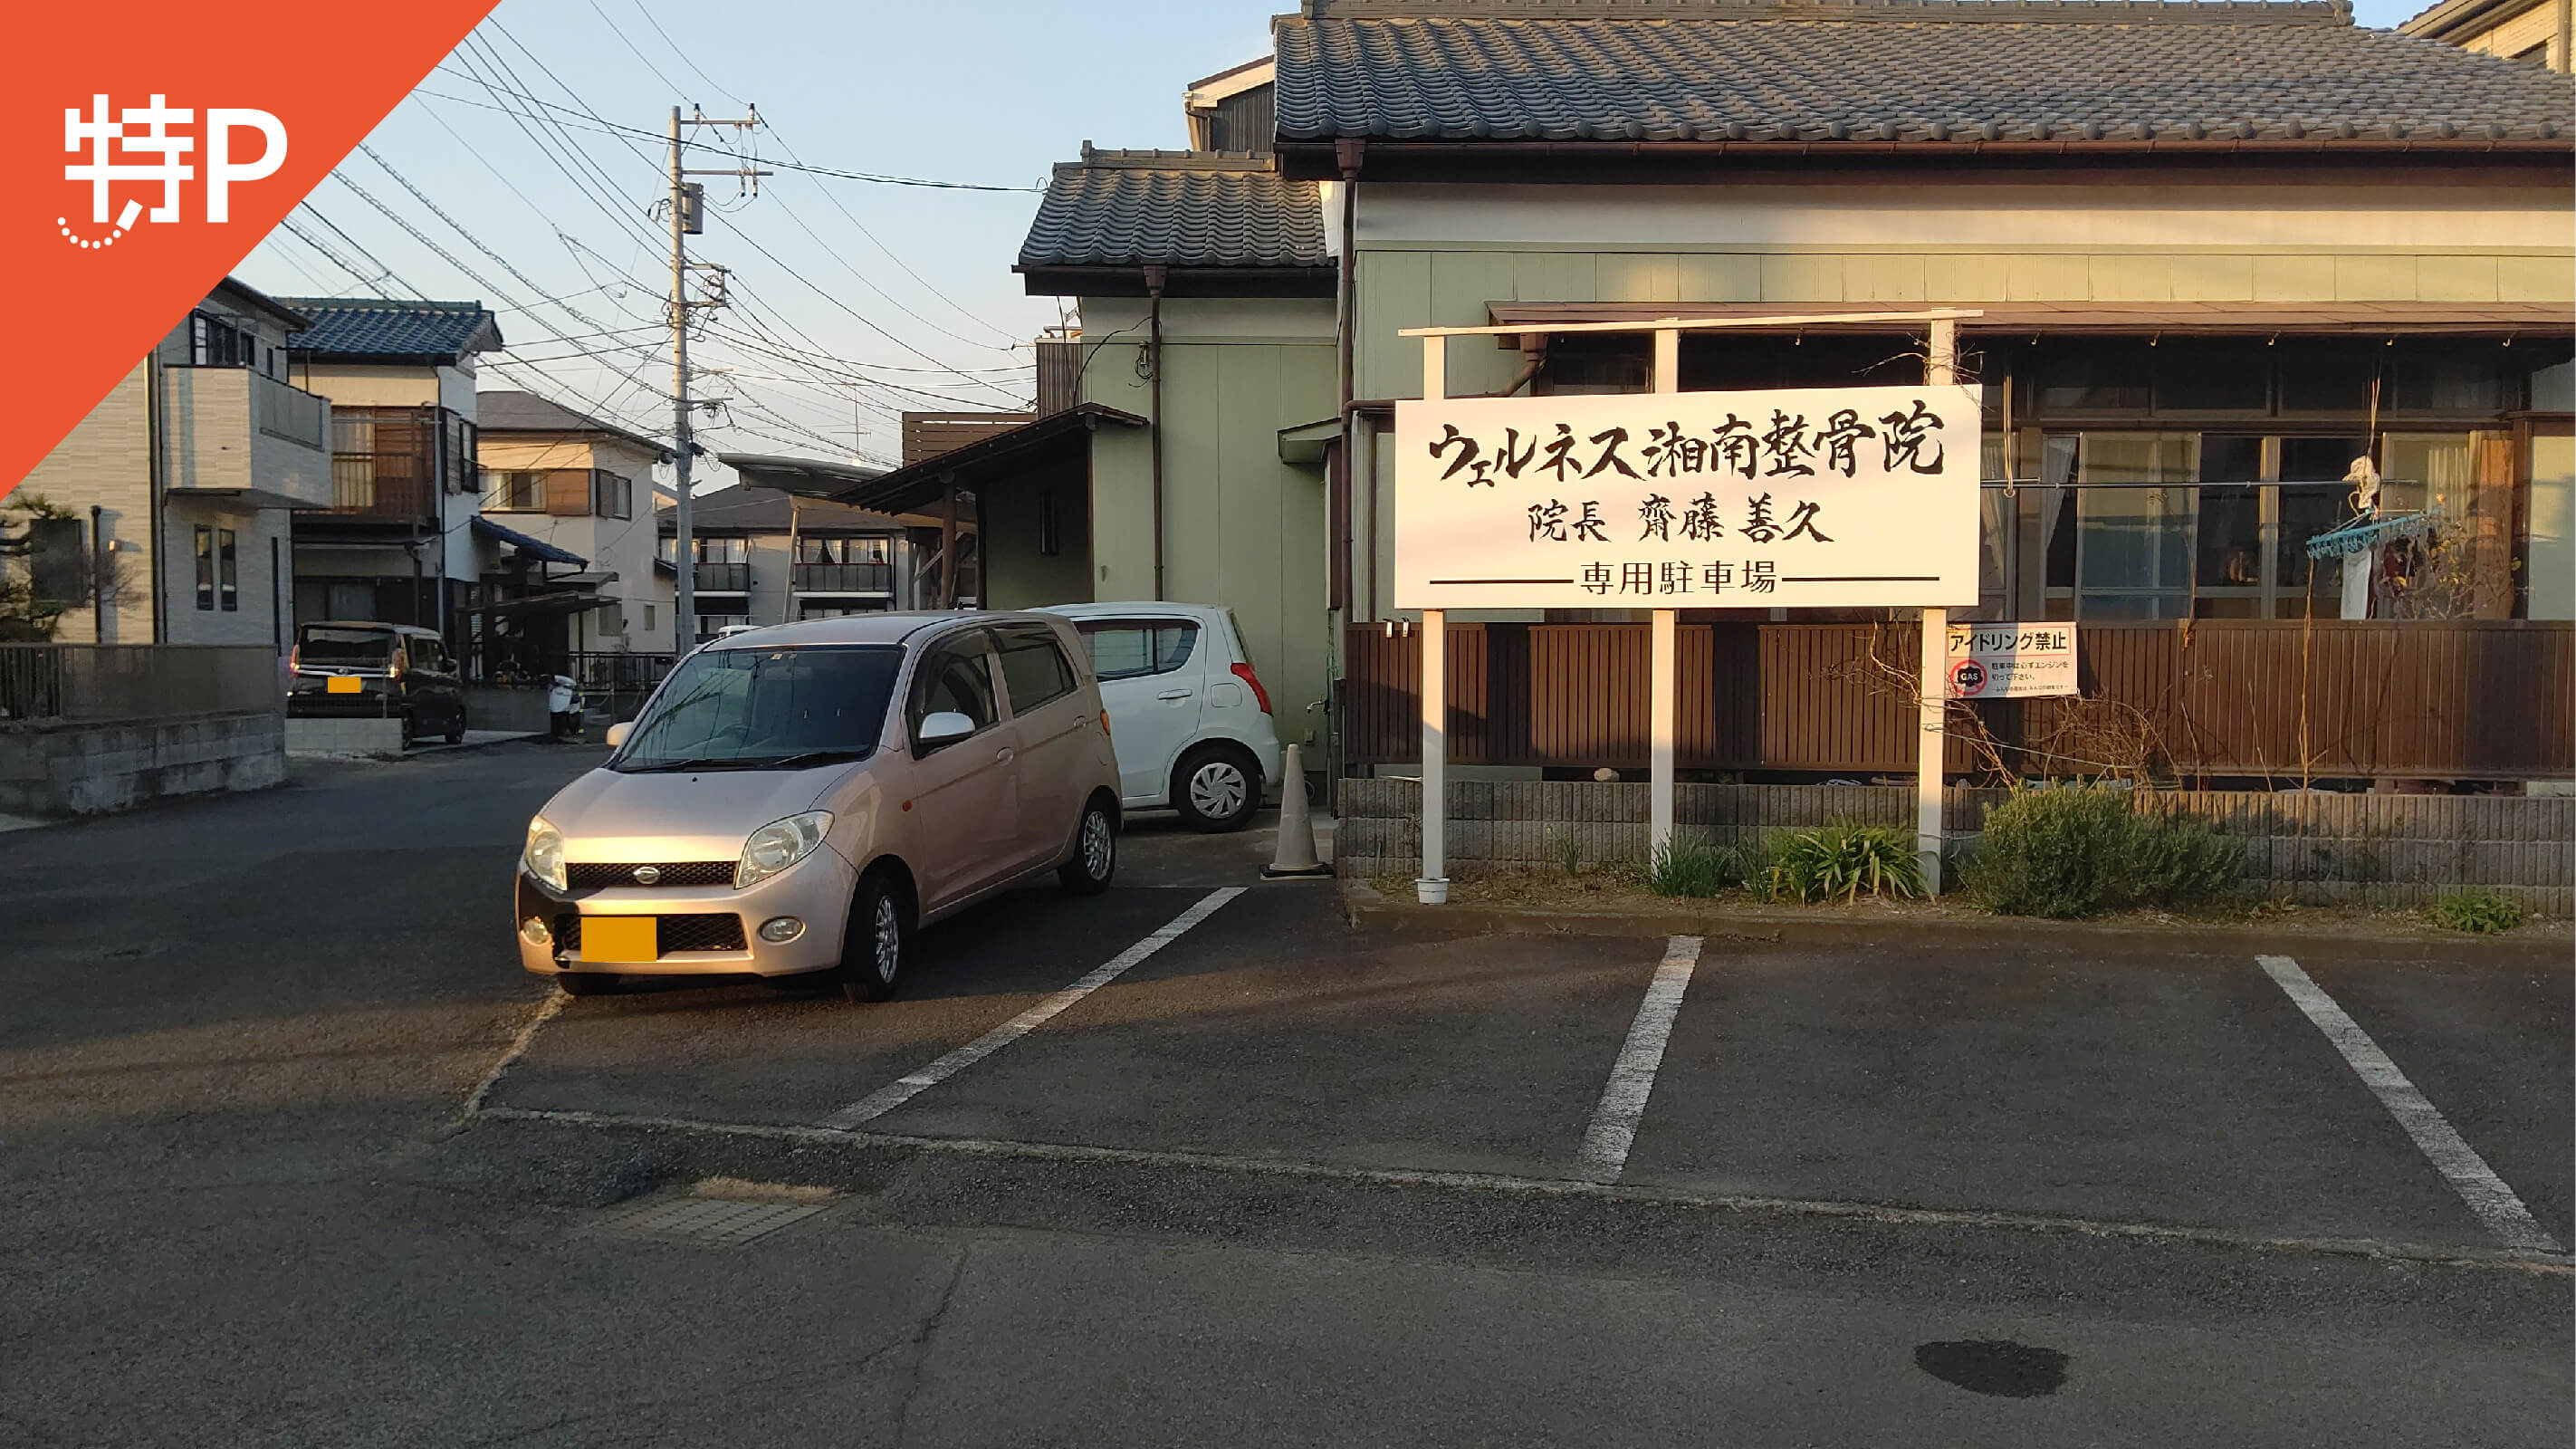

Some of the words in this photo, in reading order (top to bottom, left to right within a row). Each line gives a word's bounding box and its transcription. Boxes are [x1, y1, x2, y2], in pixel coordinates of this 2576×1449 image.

[1429, 398, 1945, 488] ウェルネス湘南整骨院
[1527, 498, 1612, 543] 院長
[1738, 491, 1834, 544] 善久
[1579, 560, 1776, 595] 専用駐車場
[1950, 631, 2067, 652] アイドリング禁止
[1960, 672, 1978, 681] GAS
